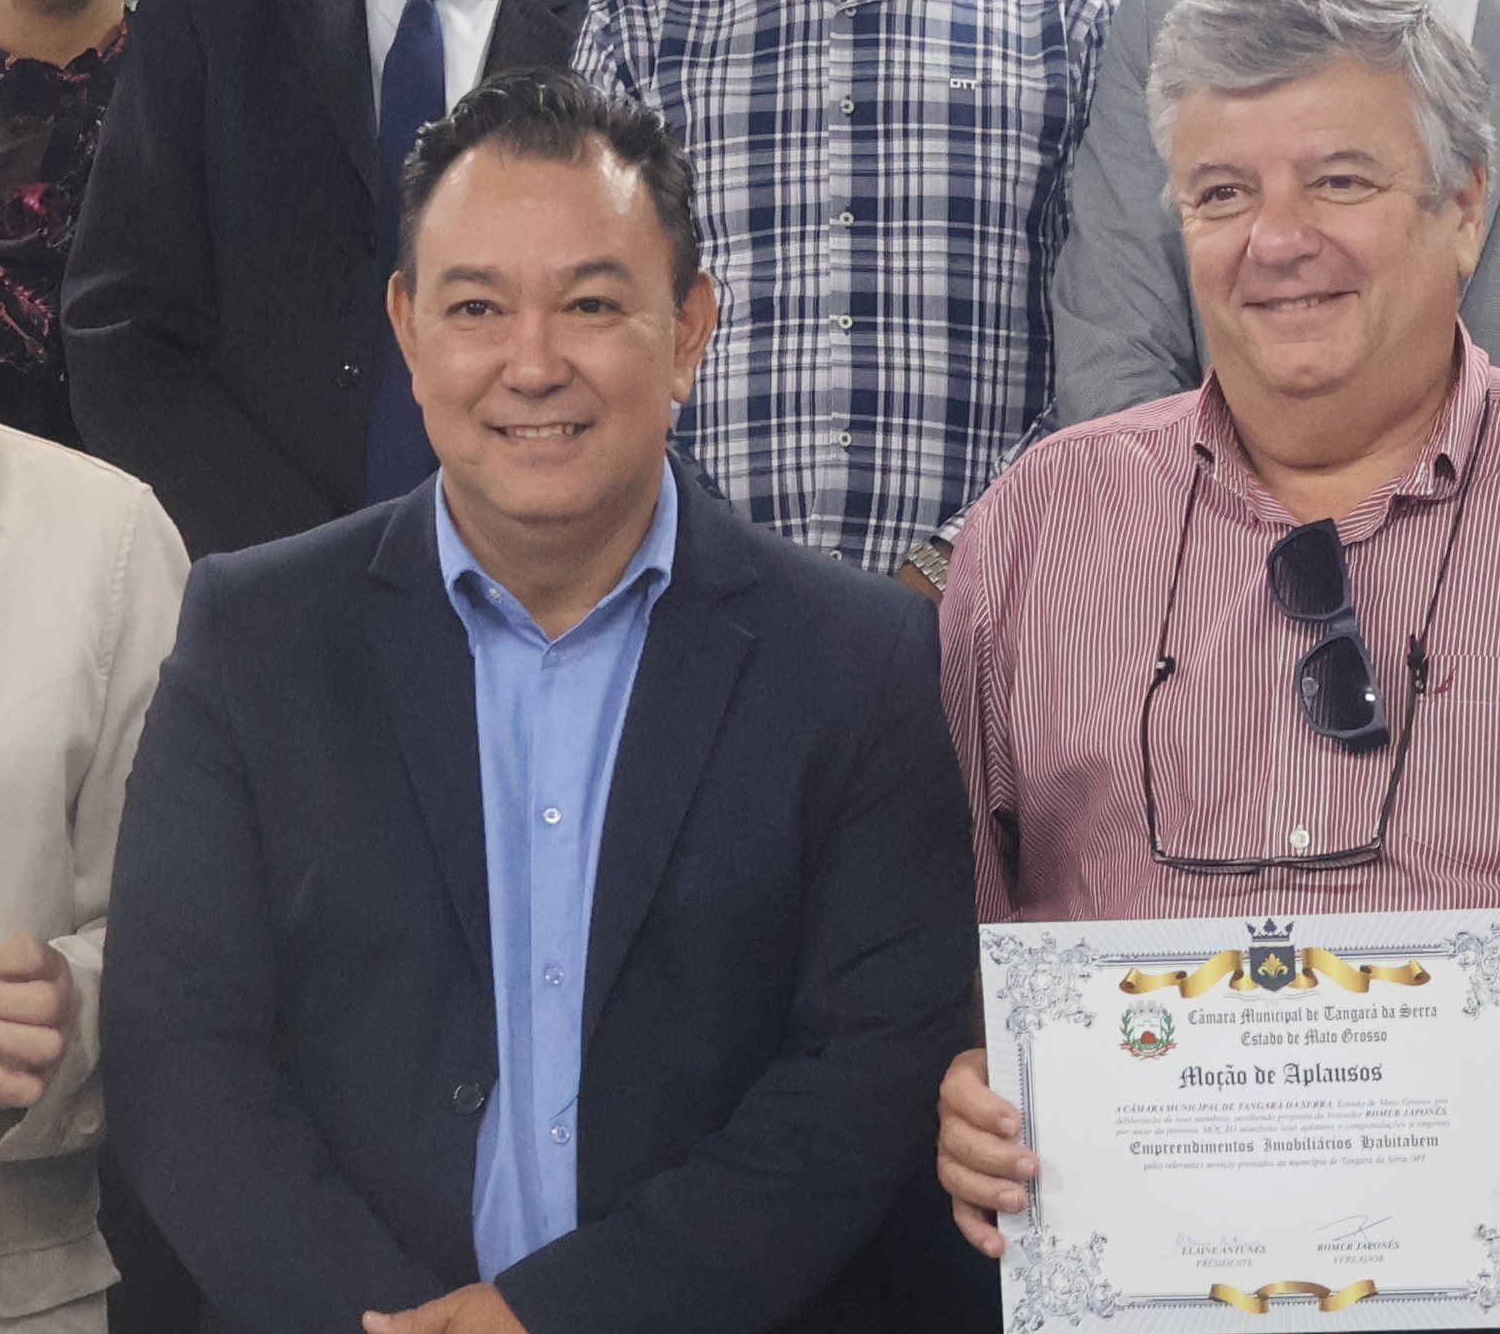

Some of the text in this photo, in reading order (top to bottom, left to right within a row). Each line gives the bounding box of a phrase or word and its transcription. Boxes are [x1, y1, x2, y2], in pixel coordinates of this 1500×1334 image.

[1187, 1002, 1437, 1025] Câmara Municipal de Tangará da Serra
[1239, 1027, 1387, 1047] Estado de Mato Grosso
[1177, 1061, 1382, 1092] Moção de Aplausos
[1128, 1133, 1438, 1156] Empreendimentos Imobiliários Habitabem
